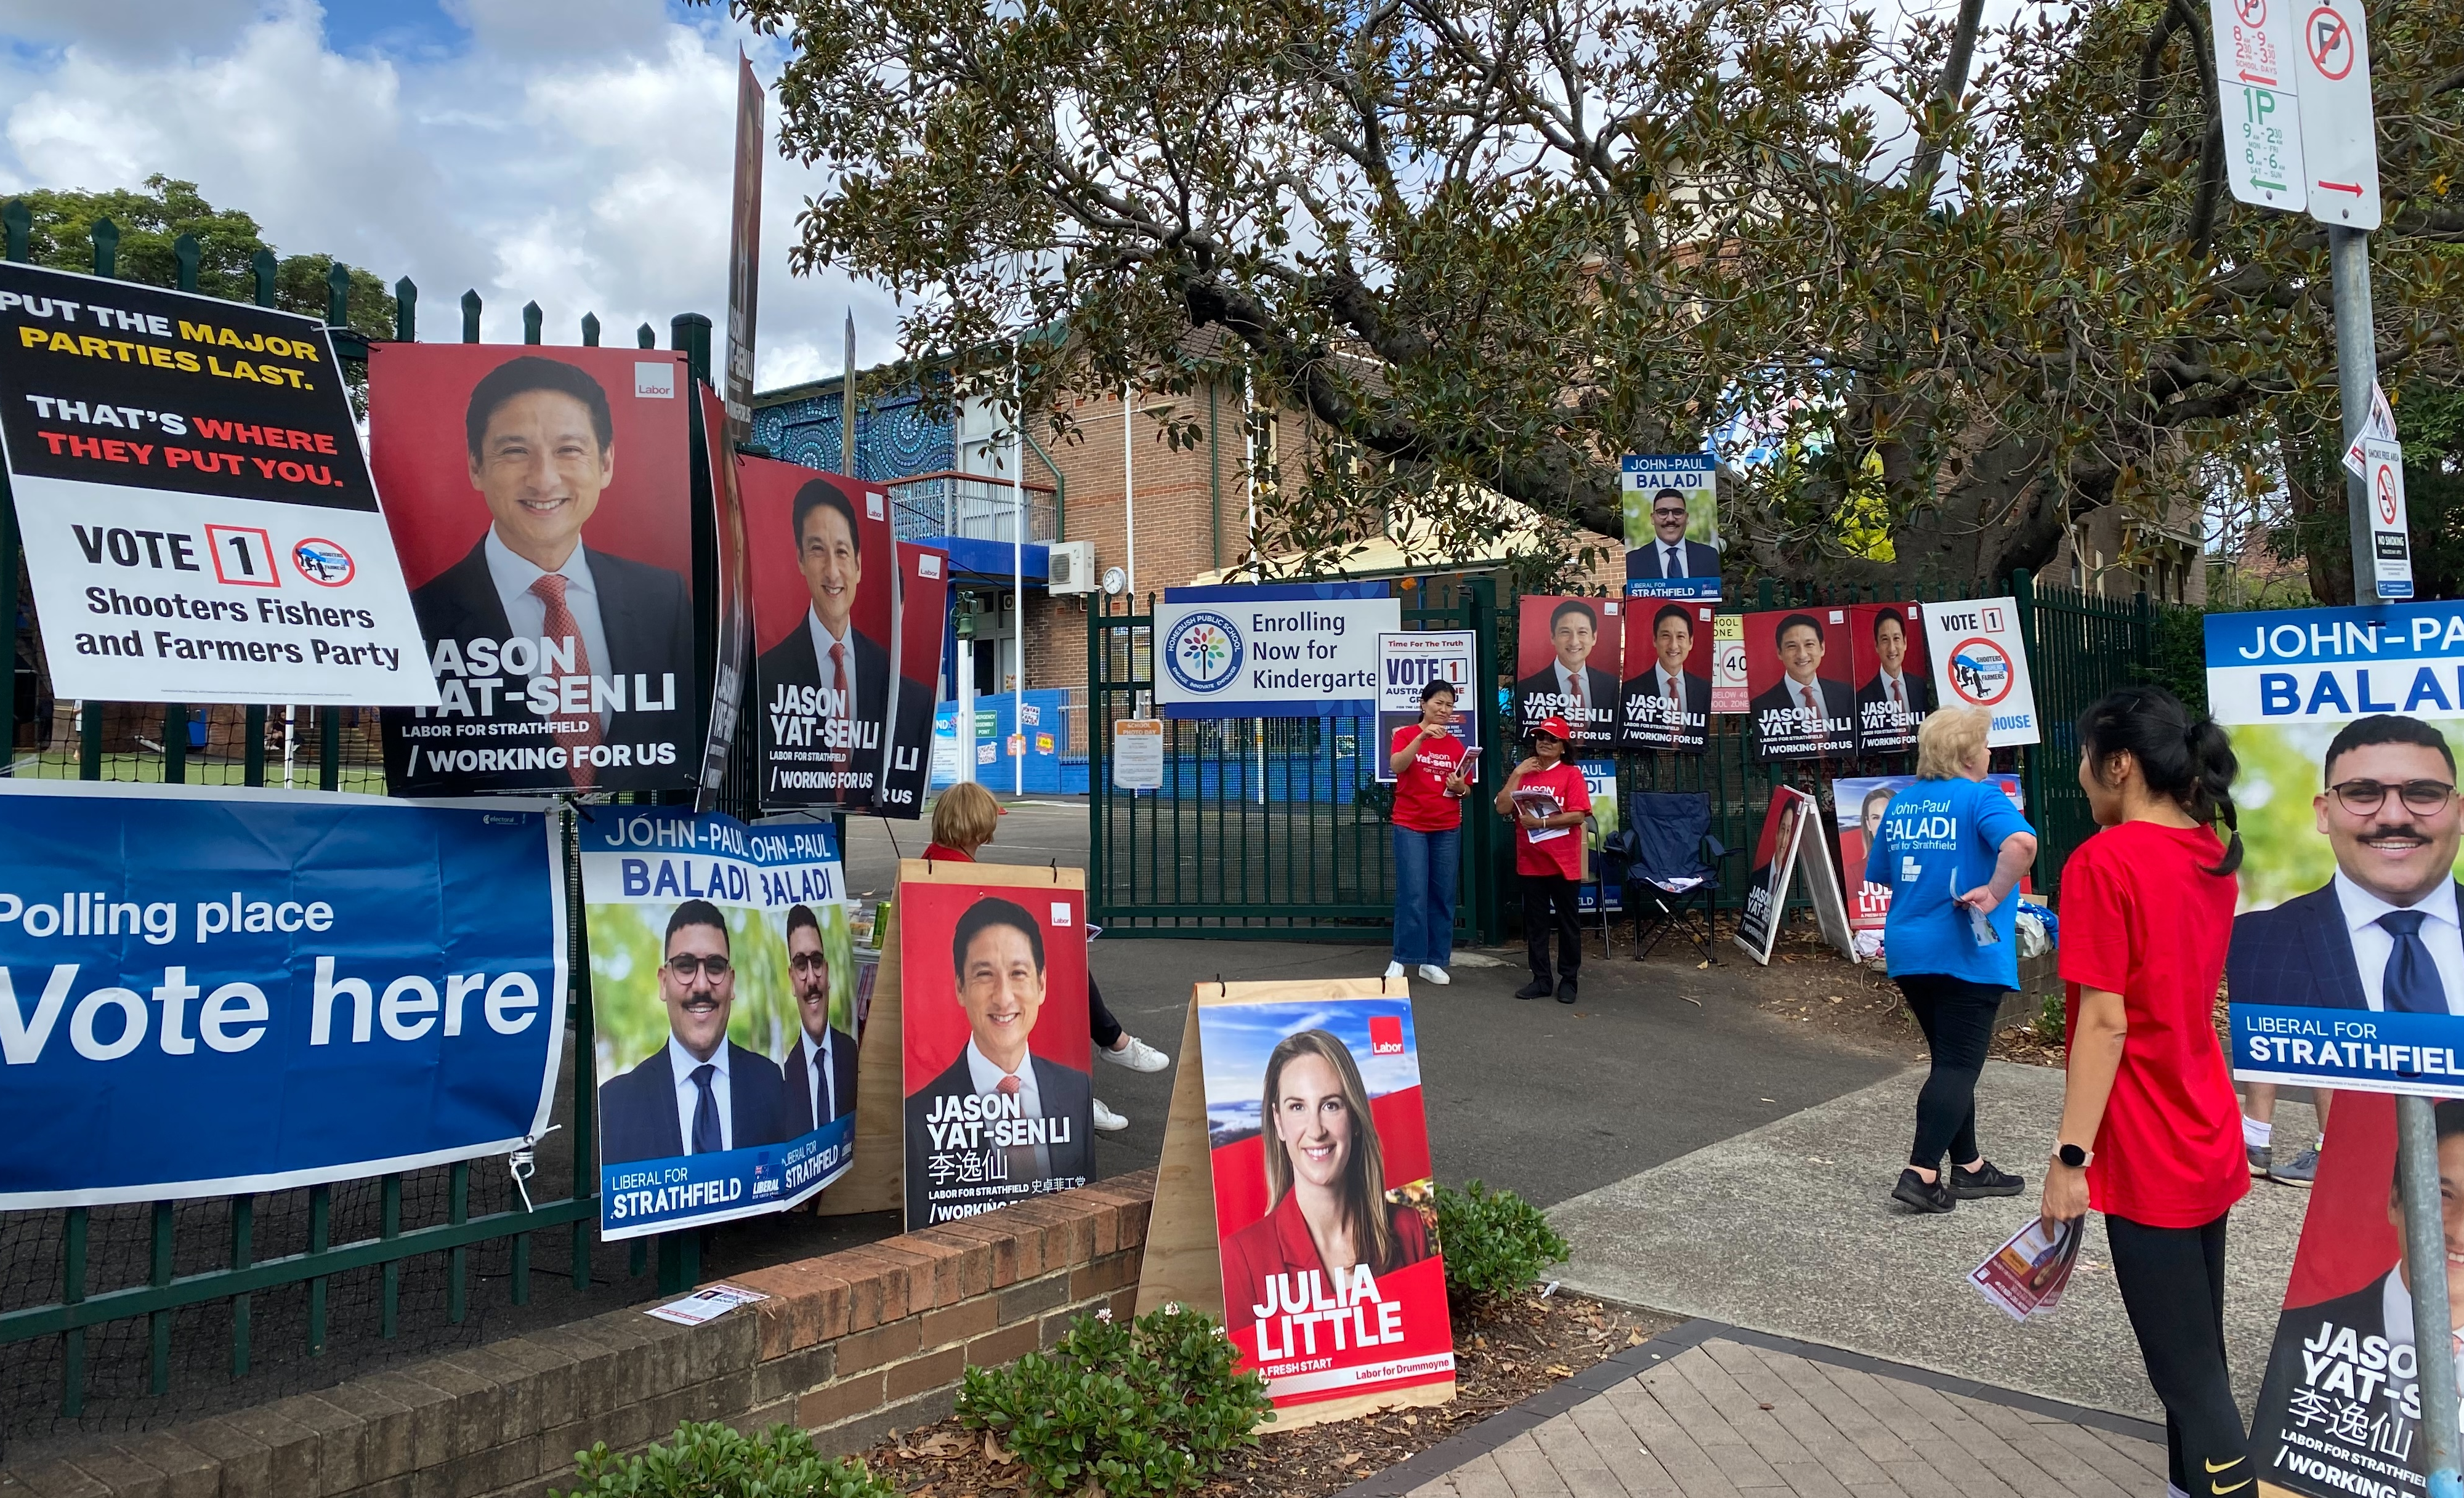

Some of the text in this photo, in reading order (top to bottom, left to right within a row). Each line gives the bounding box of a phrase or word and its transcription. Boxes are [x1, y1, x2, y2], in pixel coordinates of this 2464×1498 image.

[2236, 60, 2277, 74] SCHOOL DAYS
[2244, 87, 2276, 125] 1P
[2248, 141, 2261, 149] MON
[2250, 166, 2282, 179] SAT SUN
[0, 291, 320, 362] PUT THE MAJOR
[18, 326, 315, 390] PARTIES LAST.
[639, 385, 671, 394] Labor
[25, 394, 339, 456] THAT'S WHERE
[38, 431, 344, 488] THEY PUT YOU.
[1631, 459, 1707, 470] JOHN-PAUL
[2369, 449, 2399, 461] SMOKE FREE AREA
[1636, 473, 1702, 488] BALADI
[868, 509, 883, 518] Labor
[71, 523, 255, 575] VOTE 1
[2378, 535, 2404, 546] NO SMOKING
[920, 568, 938, 577] Labor
[1632, 587, 1695, 597] STRATHFIELD
[87, 586, 375, 629] Shooters Fishers
[1253, 611, 1345, 636] Enrolling
[1941, 612, 1997, 632] VOTE 1
[1168, 615, 1241, 653] HOMEBUSH PUBLIC SCHOOL
[75, 630, 400, 672] and Farmers Party
[1253, 640, 1338, 660] Now for
[1386, 658, 1457, 685] VOTE 1
[1726, 656, 1748, 671] 40
[1172, 667, 1189, 684] ENGAGE
[1216, 666, 1237, 686] EMPOWER
[1253, 669, 1375, 693] Kindergarte
[634, 672, 676, 712] LI
[770, 683, 846, 718] JASON
[1524, 692, 1581, 707] JASON
[1626, 694, 1678, 711] JASON
[1861, 700, 1902, 716] JASON
[1599, 709, 1612, 722] LI
[1626, 708, 1691, 725] YAT-SEN
[1758, 706, 1817, 723] JASON
[1861, 712, 1914, 729] YAT-SEN
[1992, 714, 2031, 731] HOUSE
[402, 720, 590, 738] LABOR FOR STRATHFIELD
[769, 714, 861, 749] YAT-SEN
[1577, 731, 1611, 740] FOR US
[1759, 717, 1851, 736] YAT-SEN LI
[1673, 735, 1703, 745] FOR US
[1818, 741, 1838, 751] FOR
[1839, 741, 1852, 749] US
[1902, 735, 1916, 744] FOR
[572, 743, 630, 768] FOR
[636, 743, 676, 765] US
[769, 750, 846, 763] LABOR FOR STRATHFIELD
[896, 745, 919, 771] LI
[1415, 754, 1452, 768] Yat-sen
[1429, 751, 1450, 760] Jason
[838, 771, 858, 789] FOR
[859, 772, 873, 789] US
[891, 789, 912, 804] US
[1892, 800, 1950, 815] John-Paul
[605, 816, 749, 858] JOHN-PAUL
[1886, 816, 1956, 842] BALADI
[622, 858, 751, 903] BALADI
[0, 892, 334, 944] Polling place
[0, 956, 539, 1065] Vote here
[2247, 1016, 2377, 1039] LIBERAL FOR
[1373, 1042, 1403, 1053] Labor
[2249, 1036, 2464, 1075] STRATHFIEL
[926, 1093, 1020, 1123] JASON
[926, 1117, 1070, 1150] YAT-SEN LI
[786, 1145, 838, 1188] STRATHFIELD
[929, 1149, 1008, 1185] 李逸仙
[612, 1167, 688, 1191] LIBERAL FOR
[753, 1178, 779, 1194] LIBERAL
[613, 1178, 741, 1218] STRATHFIELD
[929, 1184, 1029, 1200] LABOR FOR STRATHFIELD
[1253, 1263, 1382, 1318] JULIA
[1256, 1300, 1405, 1361] LITTLE
[2304, 1321, 2417, 1379] JASO
[1267, 1357, 1332, 1376] FRESH START
[1356, 1359, 1449, 1380] Labor for Drummoyne
[2288, 1387, 2413, 1462] 李逸仙
[2281, 1428, 2351, 1461] LABOR FOR
